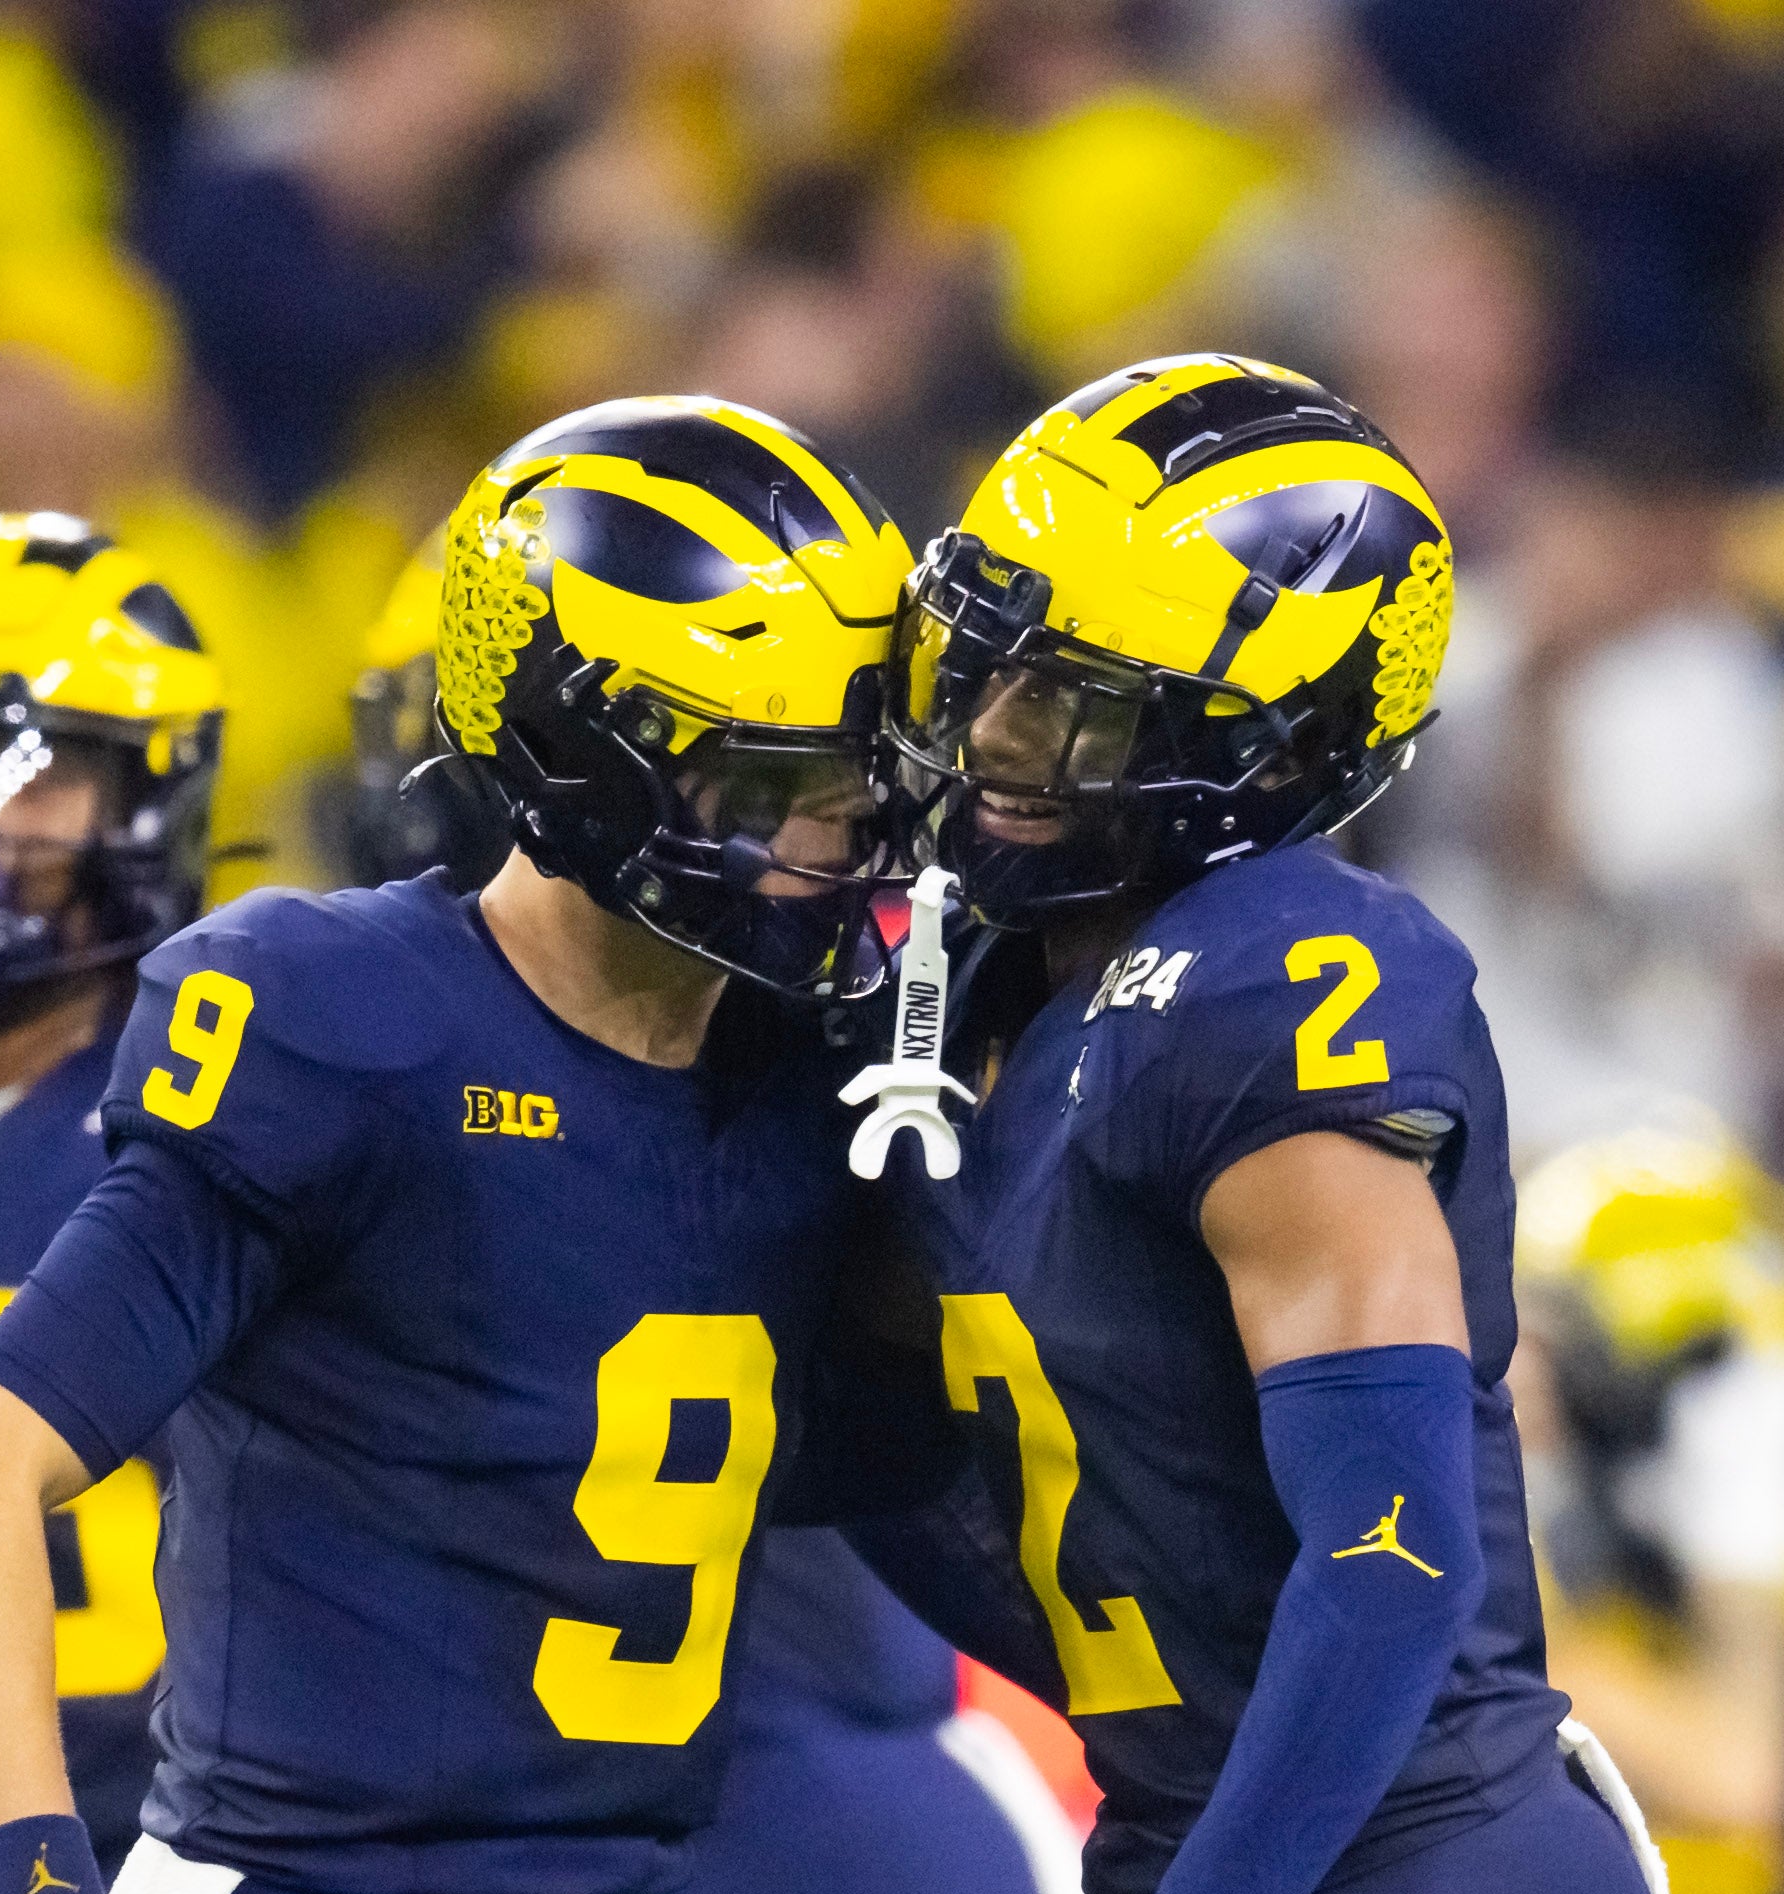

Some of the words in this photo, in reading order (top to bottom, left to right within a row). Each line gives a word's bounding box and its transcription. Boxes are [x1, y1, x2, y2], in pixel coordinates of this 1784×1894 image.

[142, 970, 254, 1130] 9
[902, 980, 940, 1060] NXTRND
[1285, 935, 1390, 1091] 2
[533, 1313, 778, 1745] 9
[940, 1292, 1183, 1716] 2
